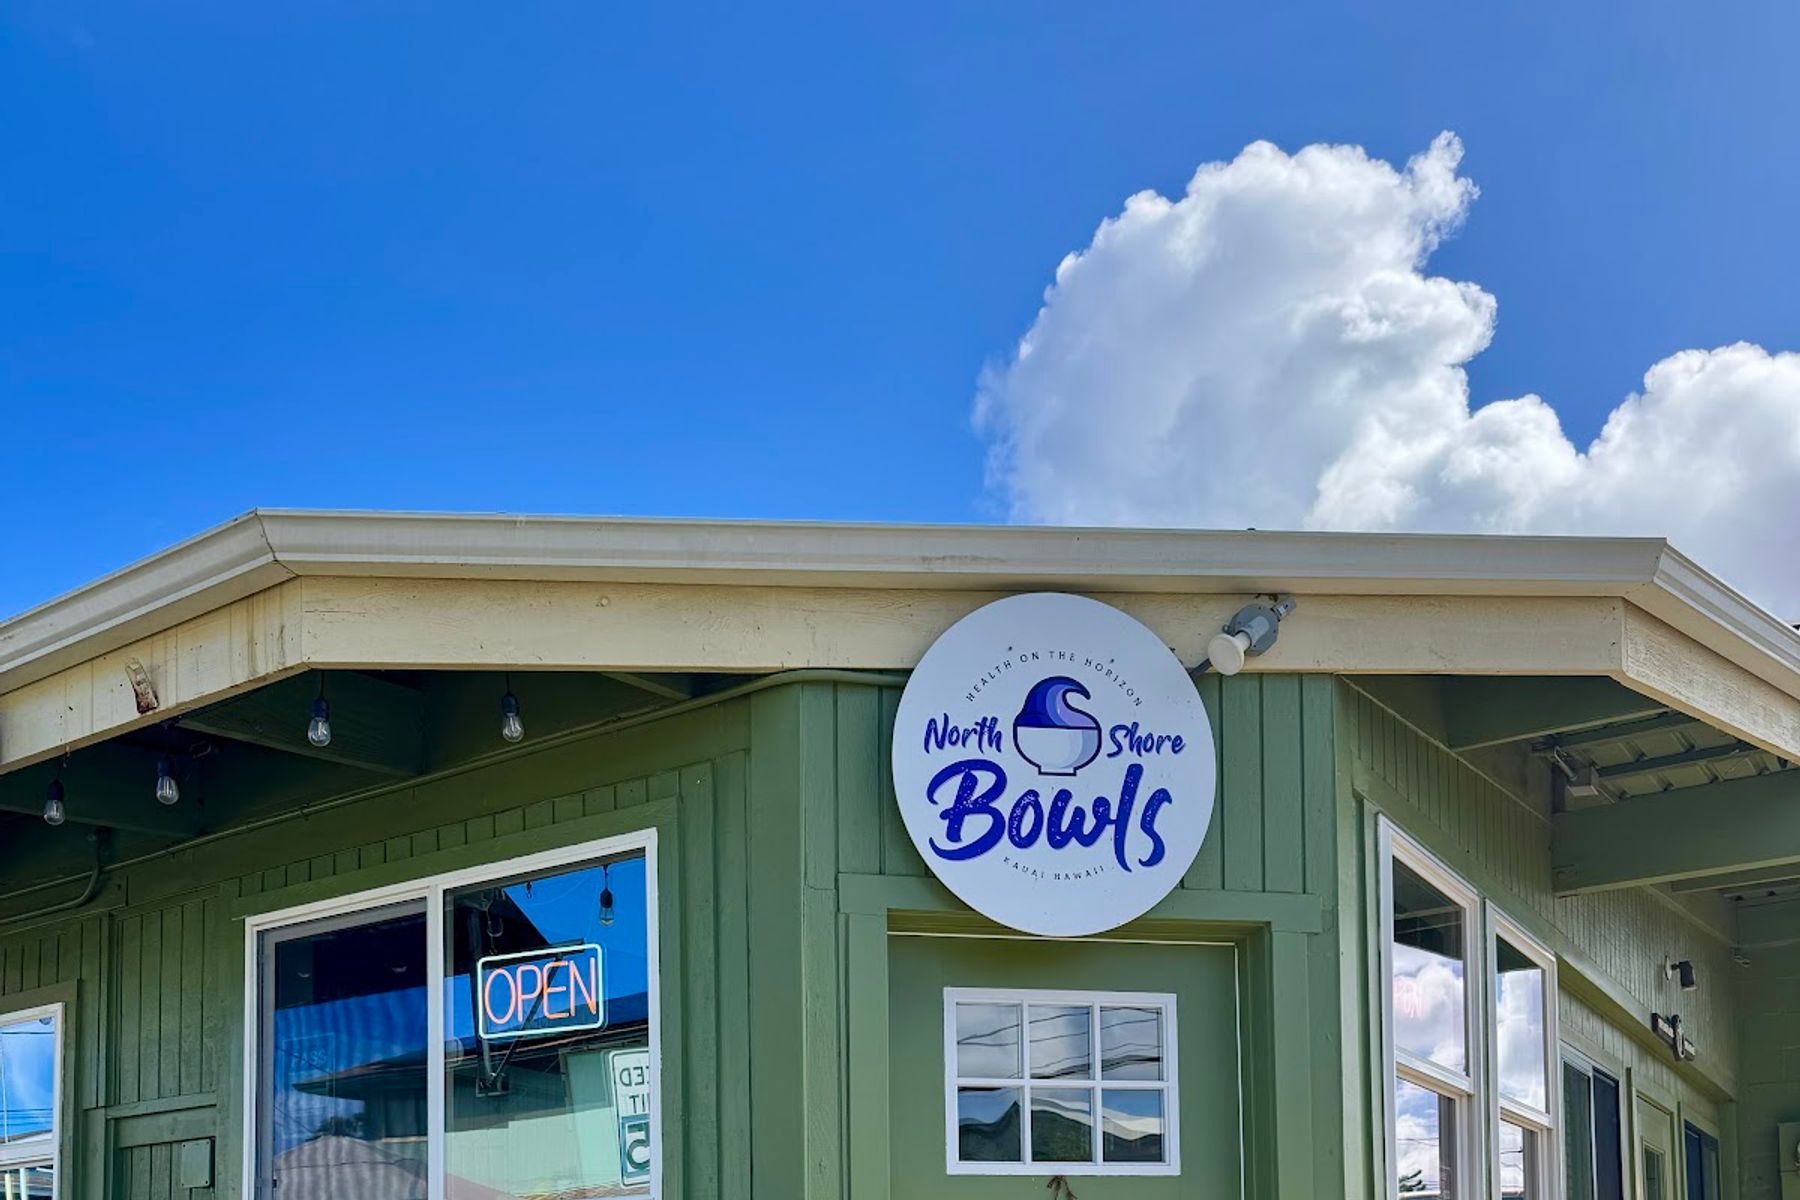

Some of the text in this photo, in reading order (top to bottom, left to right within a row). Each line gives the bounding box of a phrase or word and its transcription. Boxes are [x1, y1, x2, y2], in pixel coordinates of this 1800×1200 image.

[966, 651, 1143, 707] HEALTH ON THE HORIZON
[923, 713, 1186, 758] North Shore
[926, 759, 1173, 873] Bowls
[1054, 865, 1104, 880] HAWAII
[484, 957, 597, 1025] OPEN
